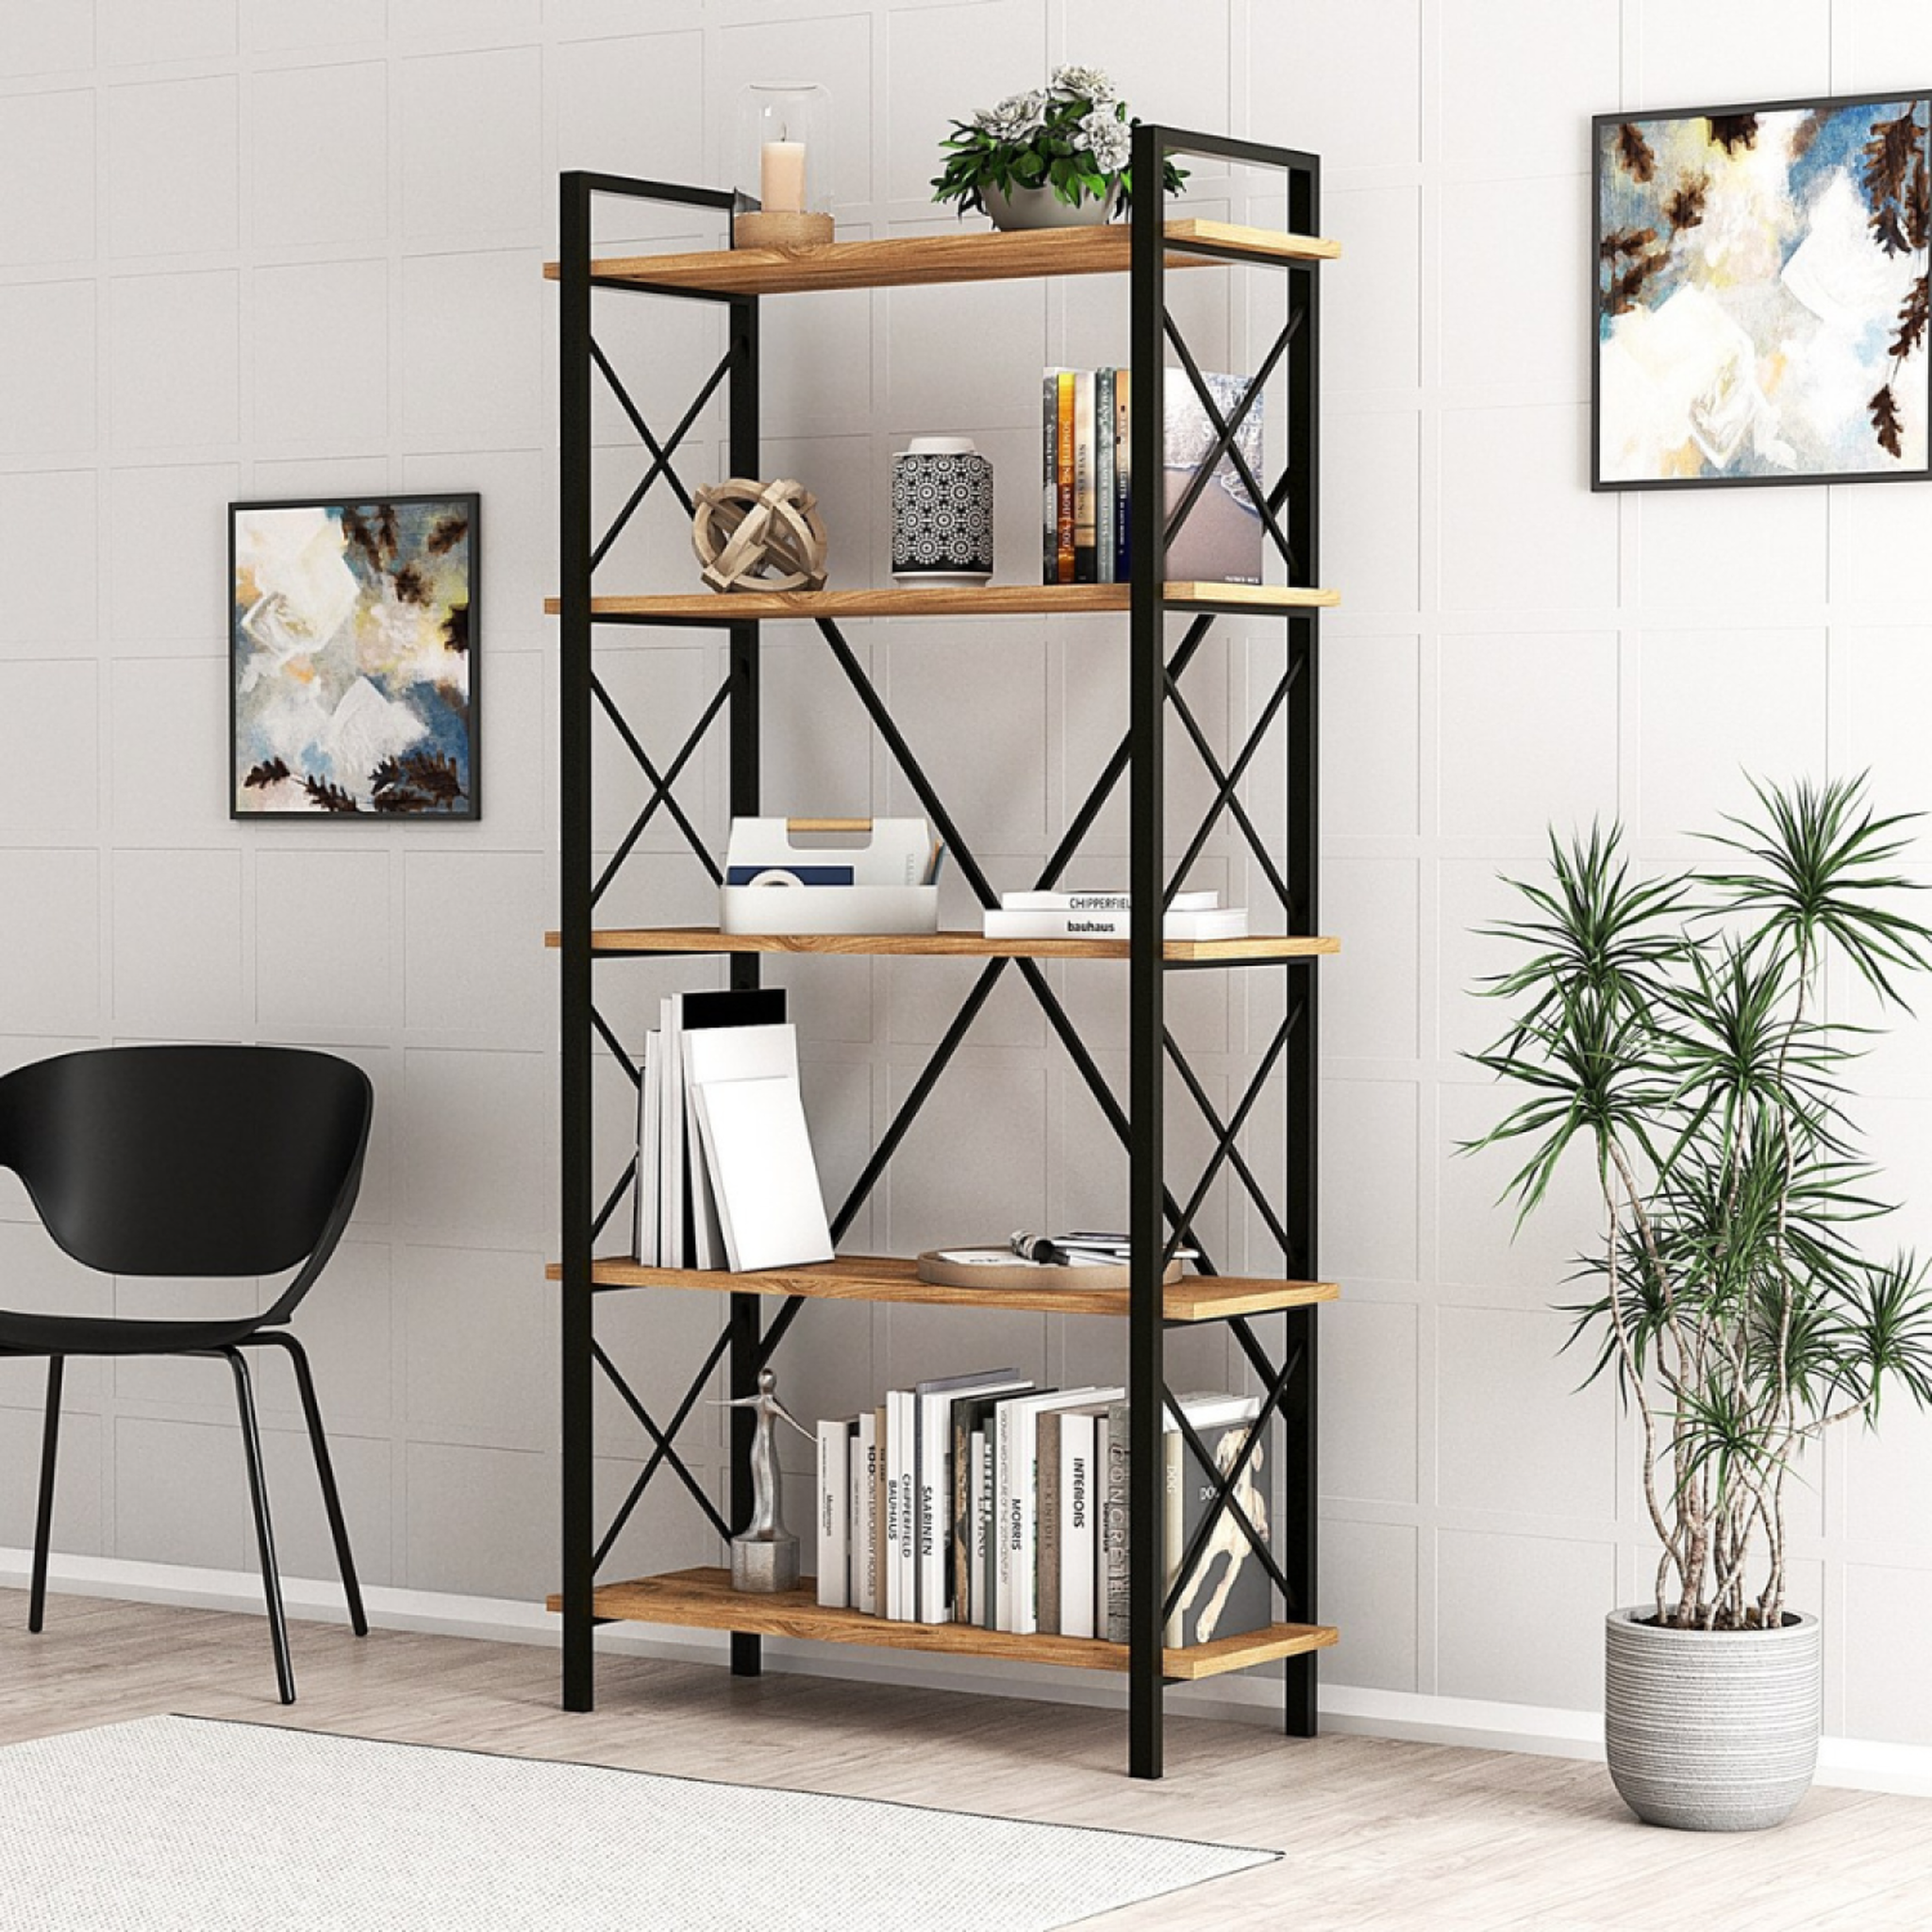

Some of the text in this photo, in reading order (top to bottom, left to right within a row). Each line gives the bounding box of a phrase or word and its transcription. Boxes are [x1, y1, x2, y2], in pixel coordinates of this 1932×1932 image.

[1062, 487, 1071, 520] ABOUT
[1062, 525, 1071, 548] YOU
[1067, 920, 1115, 932] bauhaus
[1070, 897, 1131, 908] CHIPPERFIEL
[889, 1479, 897, 1541] BAUHAUS
[902, 1474, 912, 1558] CHIPPERFIELD
[923, 1485, 932, 1556] SAARINEN
[1074, 1457, 1085, 1528] INTERIORS
[1109, 1444, 1126, 1592] CONCRETE
[1011, 1498, 1022, 1551] MORRIS
